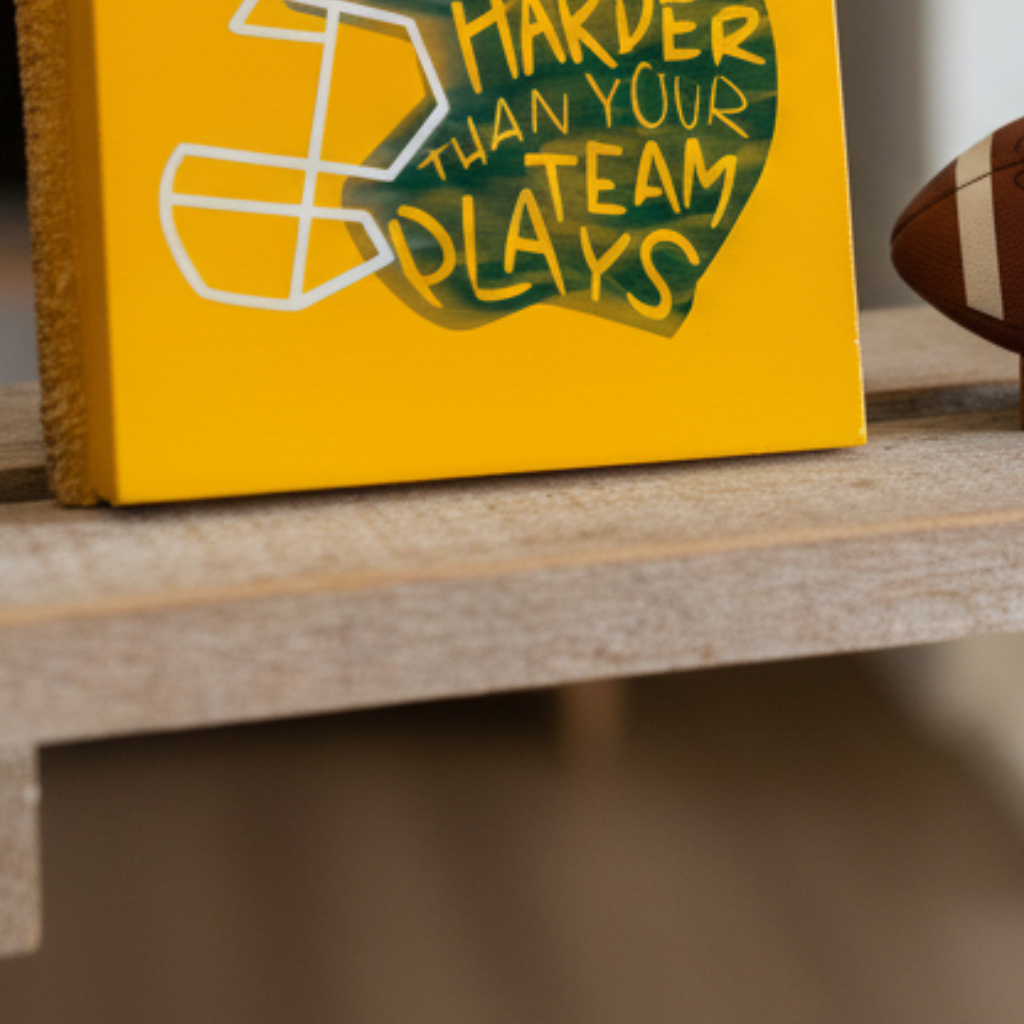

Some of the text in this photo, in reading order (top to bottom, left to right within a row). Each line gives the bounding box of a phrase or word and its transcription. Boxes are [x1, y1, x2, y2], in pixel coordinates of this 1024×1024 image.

[418, 62, 750, 181] THAN YOUR
[524, 138, 738, 229] TEAM
[388, 188, 700, 321] PLAYS
